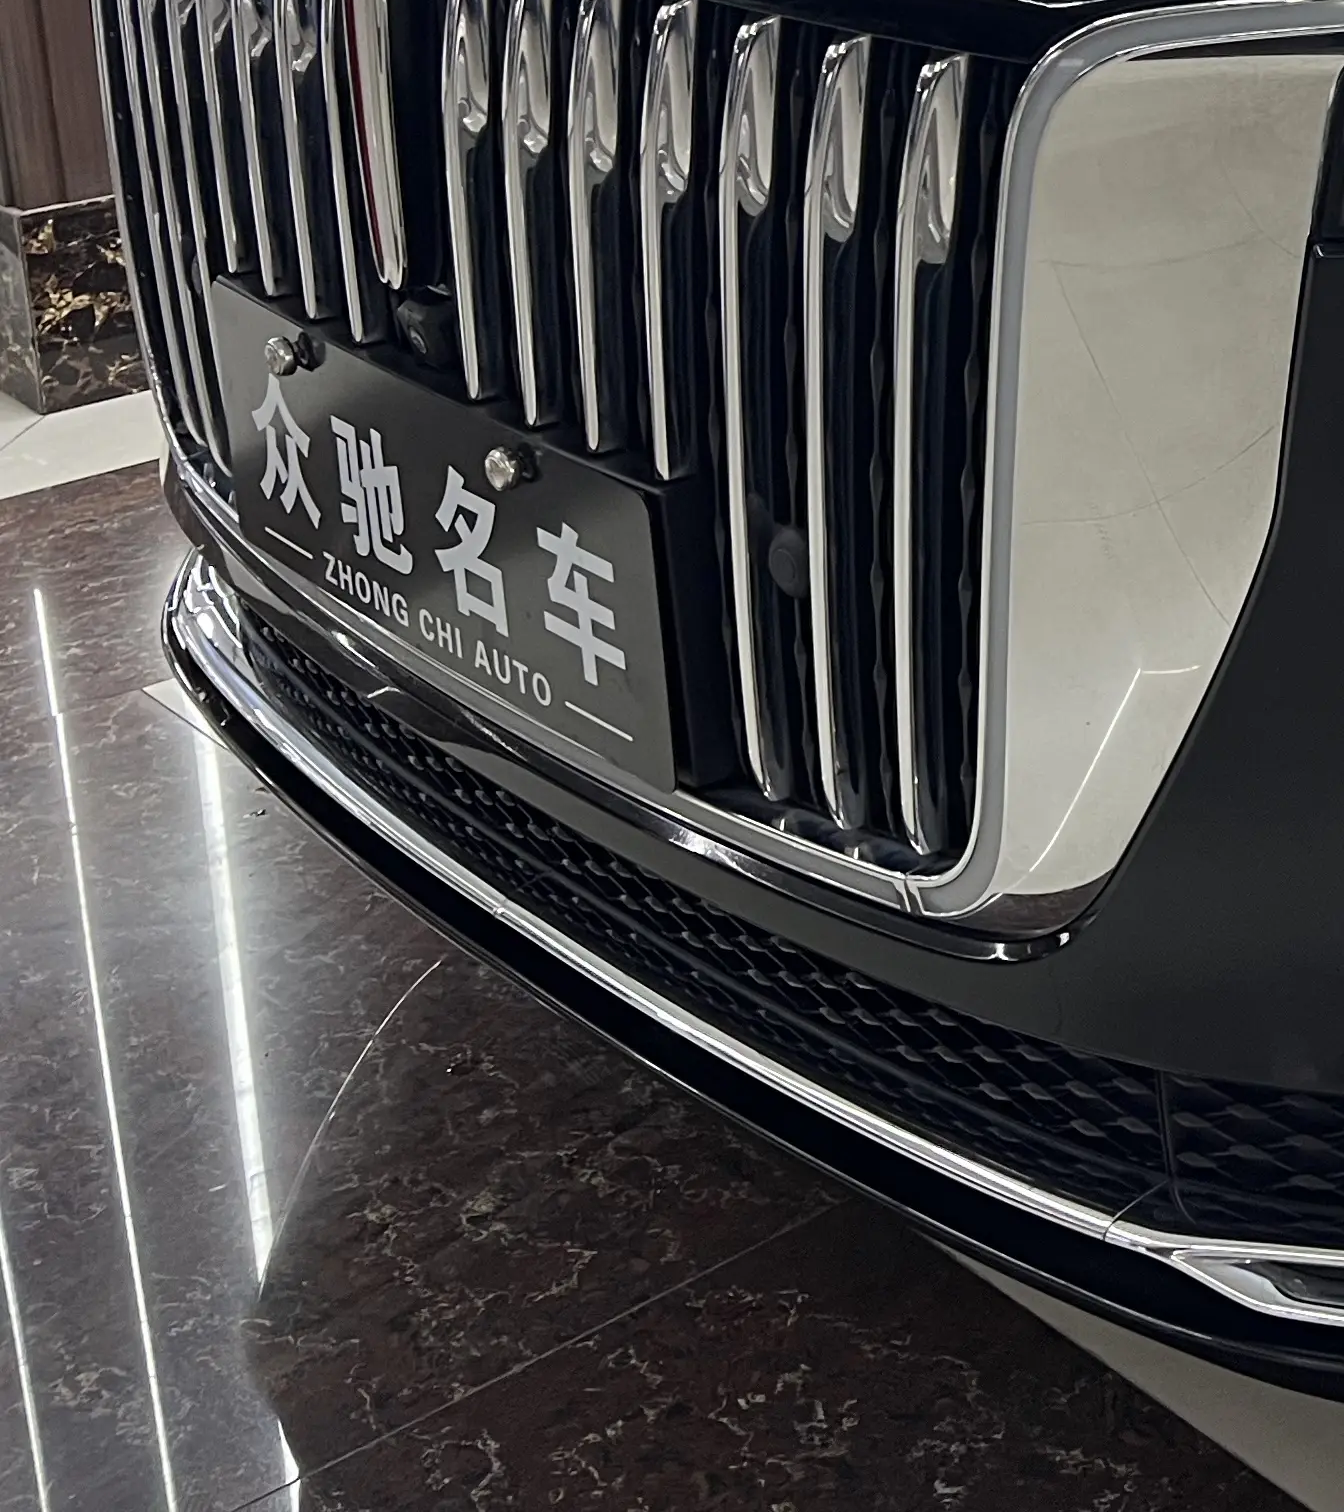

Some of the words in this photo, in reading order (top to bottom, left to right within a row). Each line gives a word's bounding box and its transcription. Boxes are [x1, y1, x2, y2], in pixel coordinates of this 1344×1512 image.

[251, 373, 626, 686] 众驰名车
[322, 550, 409, 625] ZHONG
[418, 607, 463, 660] CHI
[474, 639, 553, 708] AUTO
